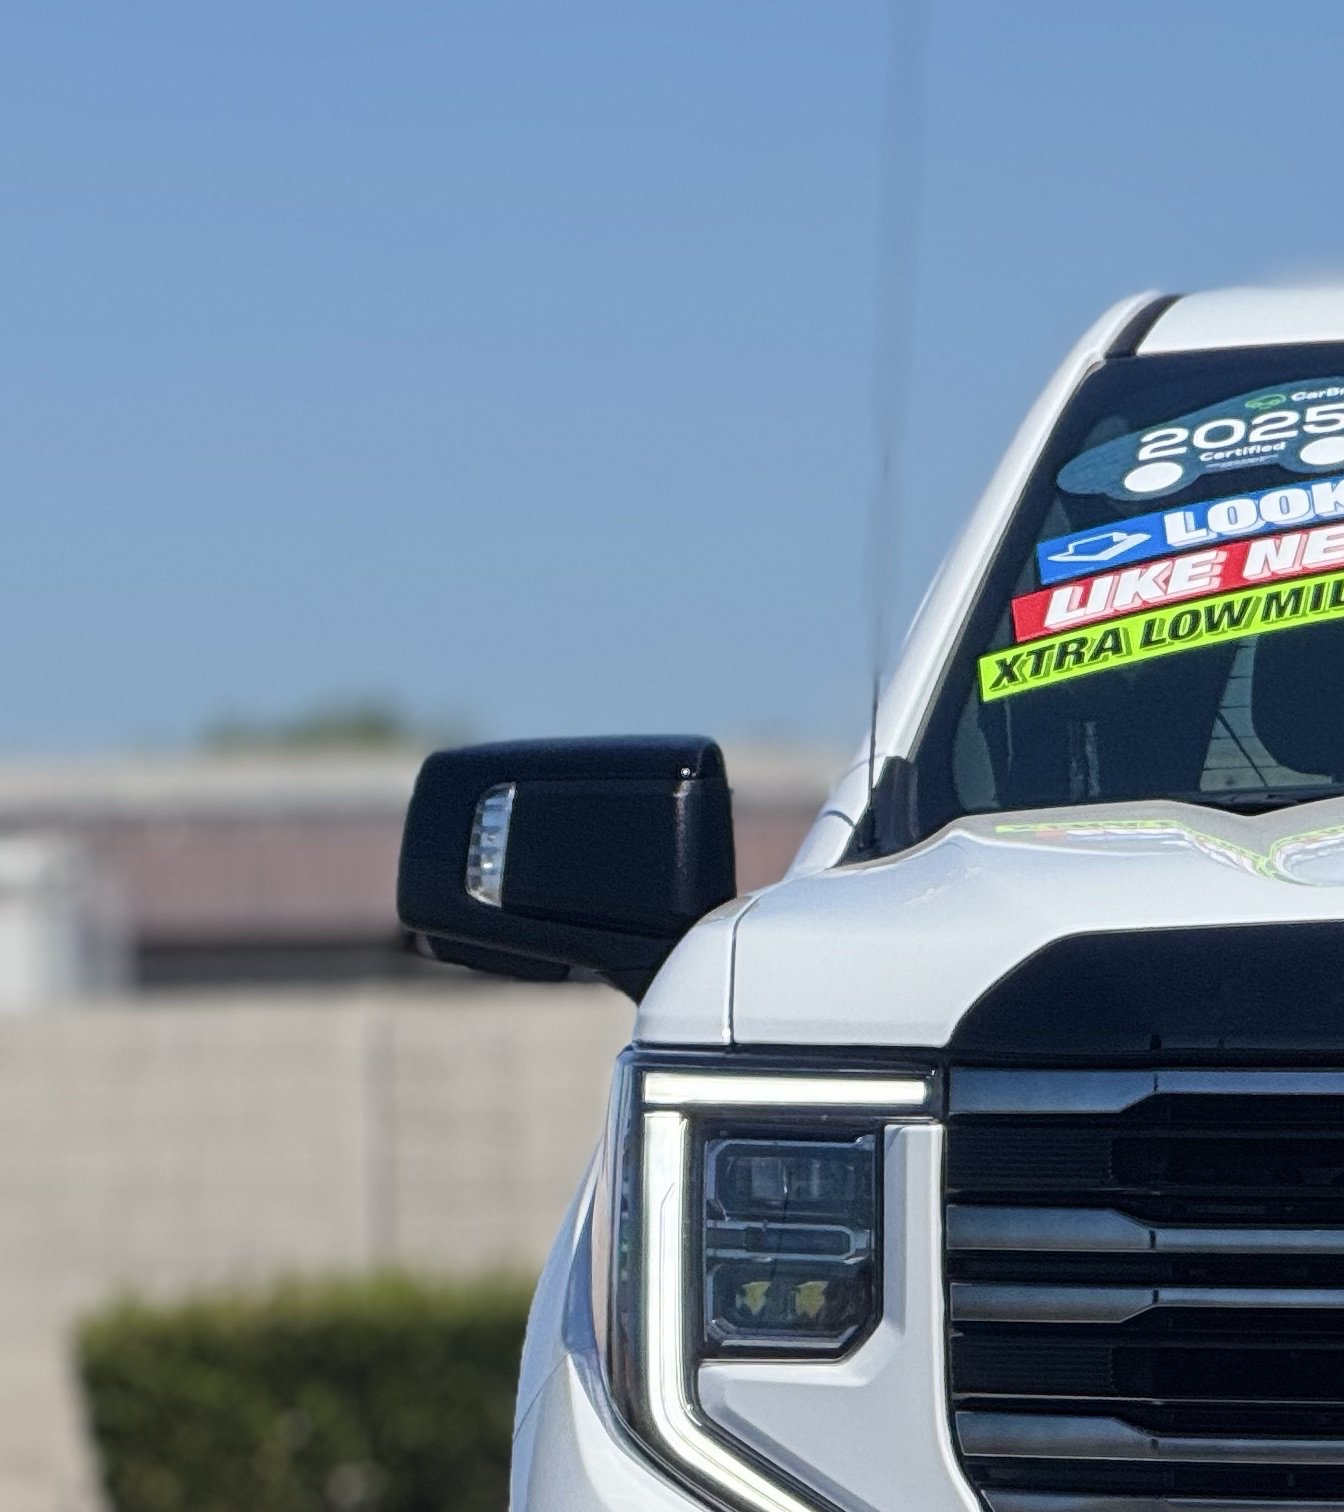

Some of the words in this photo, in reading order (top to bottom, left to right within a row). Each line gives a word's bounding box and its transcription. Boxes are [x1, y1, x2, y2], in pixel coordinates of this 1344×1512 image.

[1200, 441, 1287, 462] Certified
[1044, 549, 1228, 629] LIKE
[989, 622, 1131, 691] XTRA
[1140, 596, 1261, 652] LOW
